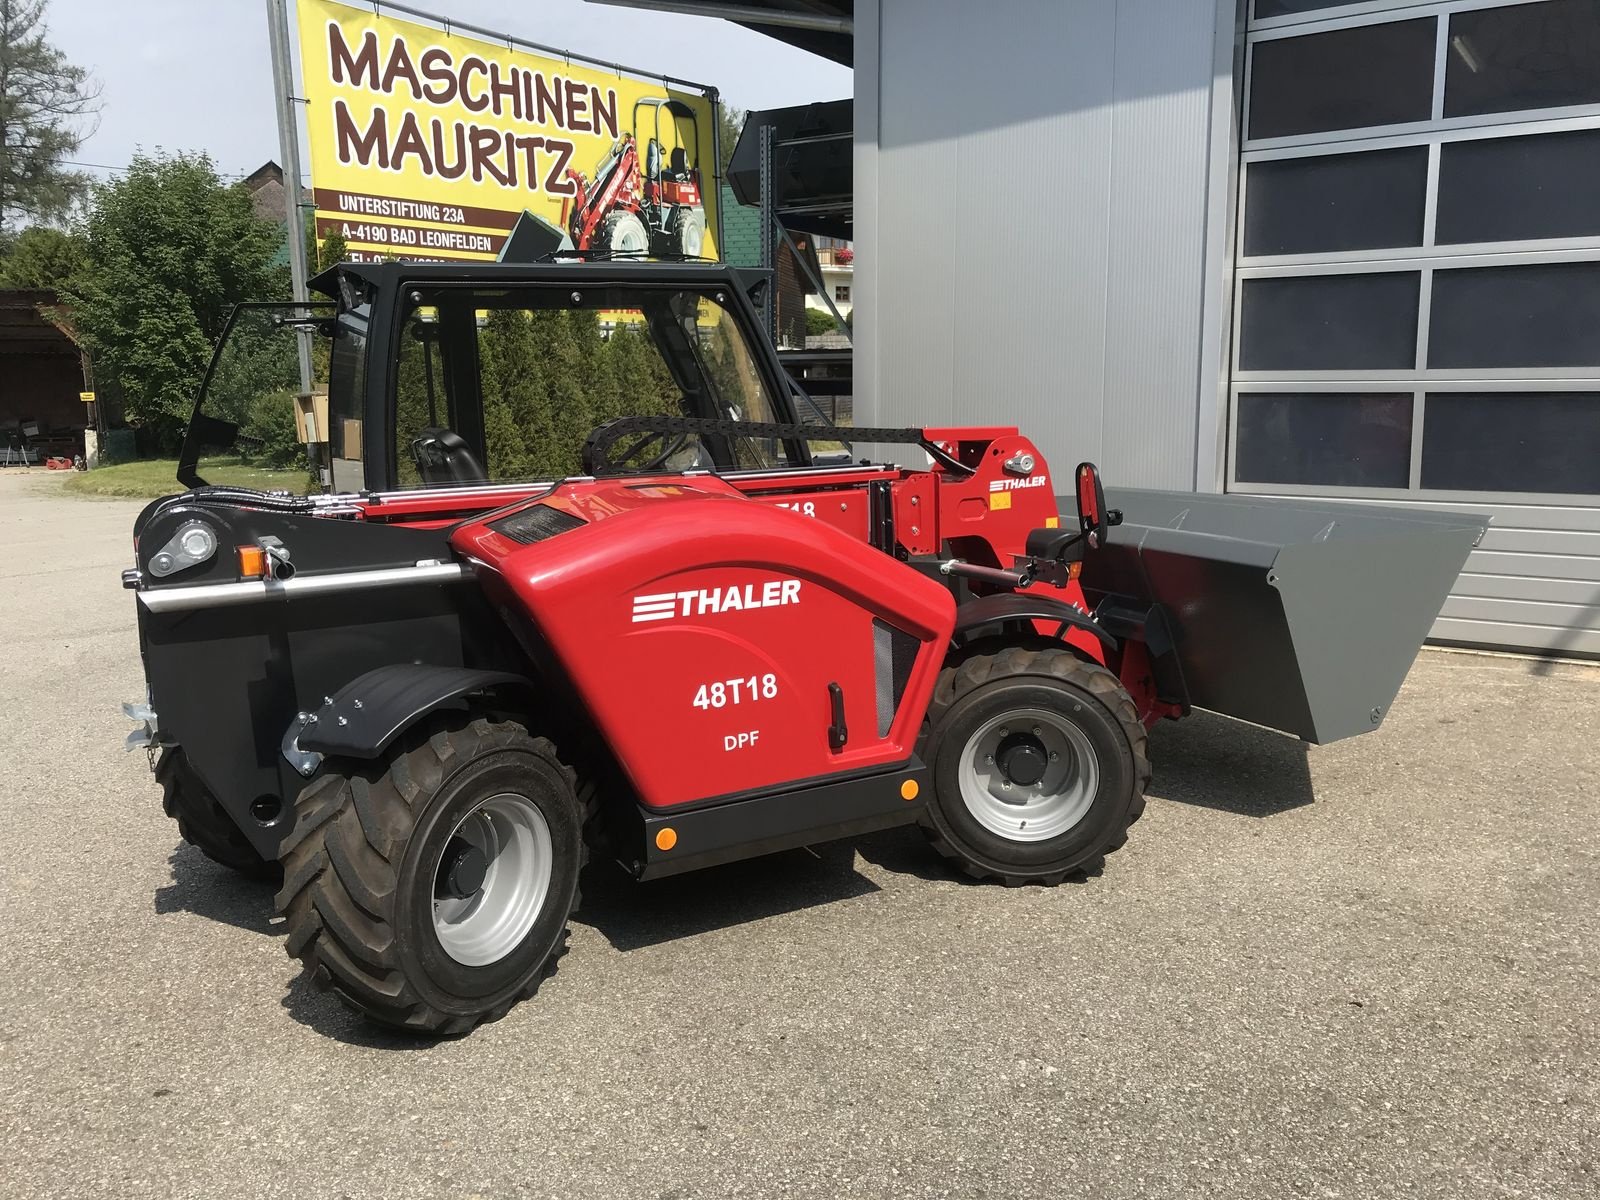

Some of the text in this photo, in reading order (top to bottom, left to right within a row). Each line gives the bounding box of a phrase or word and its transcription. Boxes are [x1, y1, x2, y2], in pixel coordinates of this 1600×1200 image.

[328, 22, 618, 138] MASCHINEN
[333, 100, 577, 196] MAURITZ
[339, 194, 465, 223] UNTERSTIFTUNG 23A
[341, 223, 492, 251] A-4190 BAD LEONFELDEN
[1003, 475, 1046, 490] THALER
[677, 580, 802, 617] THALER
[693, 673, 778, 710] 48T18
[724, 730, 760, 752] DPF
